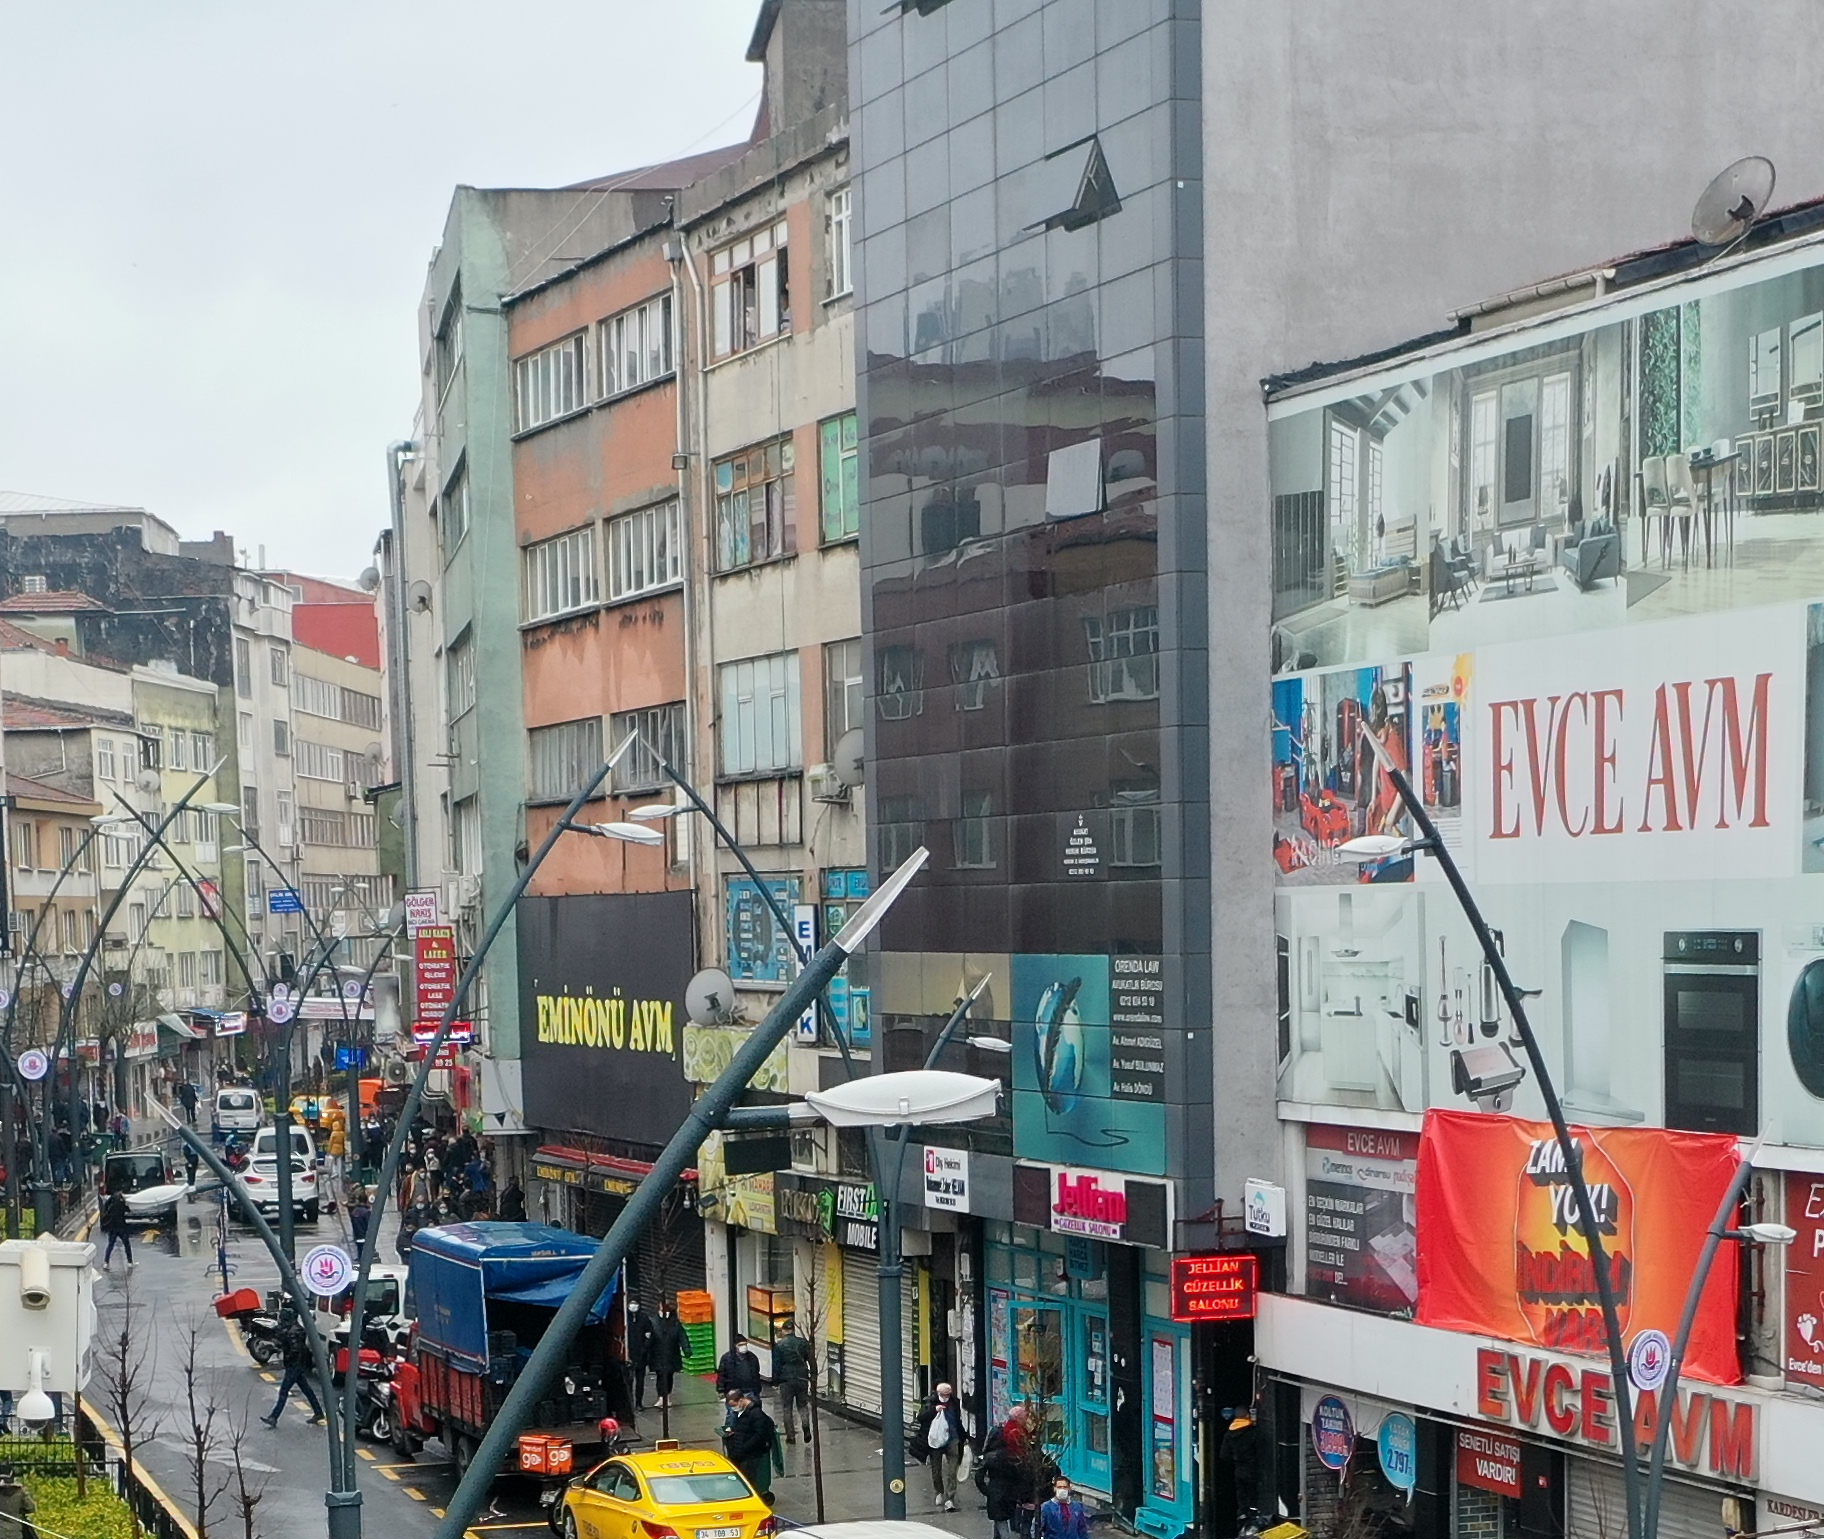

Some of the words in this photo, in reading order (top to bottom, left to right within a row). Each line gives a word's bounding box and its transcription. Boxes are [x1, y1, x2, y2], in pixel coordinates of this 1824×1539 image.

[1489, 689, 1625, 839] EVCE
[1638, 673, 1773, 832] AVM
[537, 985, 625, 1051] EMİNÖNÜ
[629, 999, 674, 1054] AVM
[1347, 1133, 1375, 1153] EVCE
[1377, 1136, 1399, 1156] AVM
[837, 1185, 865, 1217] FIRST
[847, 1223, 876, 1249] MOBILE
[1187, 1261, 1239, 1274] JELLİAN
[1184, 1278, 1244, 1293] GÜZELLİK
[1188, 1298, 1239, 1311] SALONU
[1788, 1358, 1822, 1376] Evce'den
[1478, 1348, 1619, 1449] EVCE
[1633, 1387, 1760, 1481] AVM
[1460, 1433, 1493, 1454] SENETLİ
[522, 1453, 541, 1468] go
[549, 1450, 570, 1466] go
